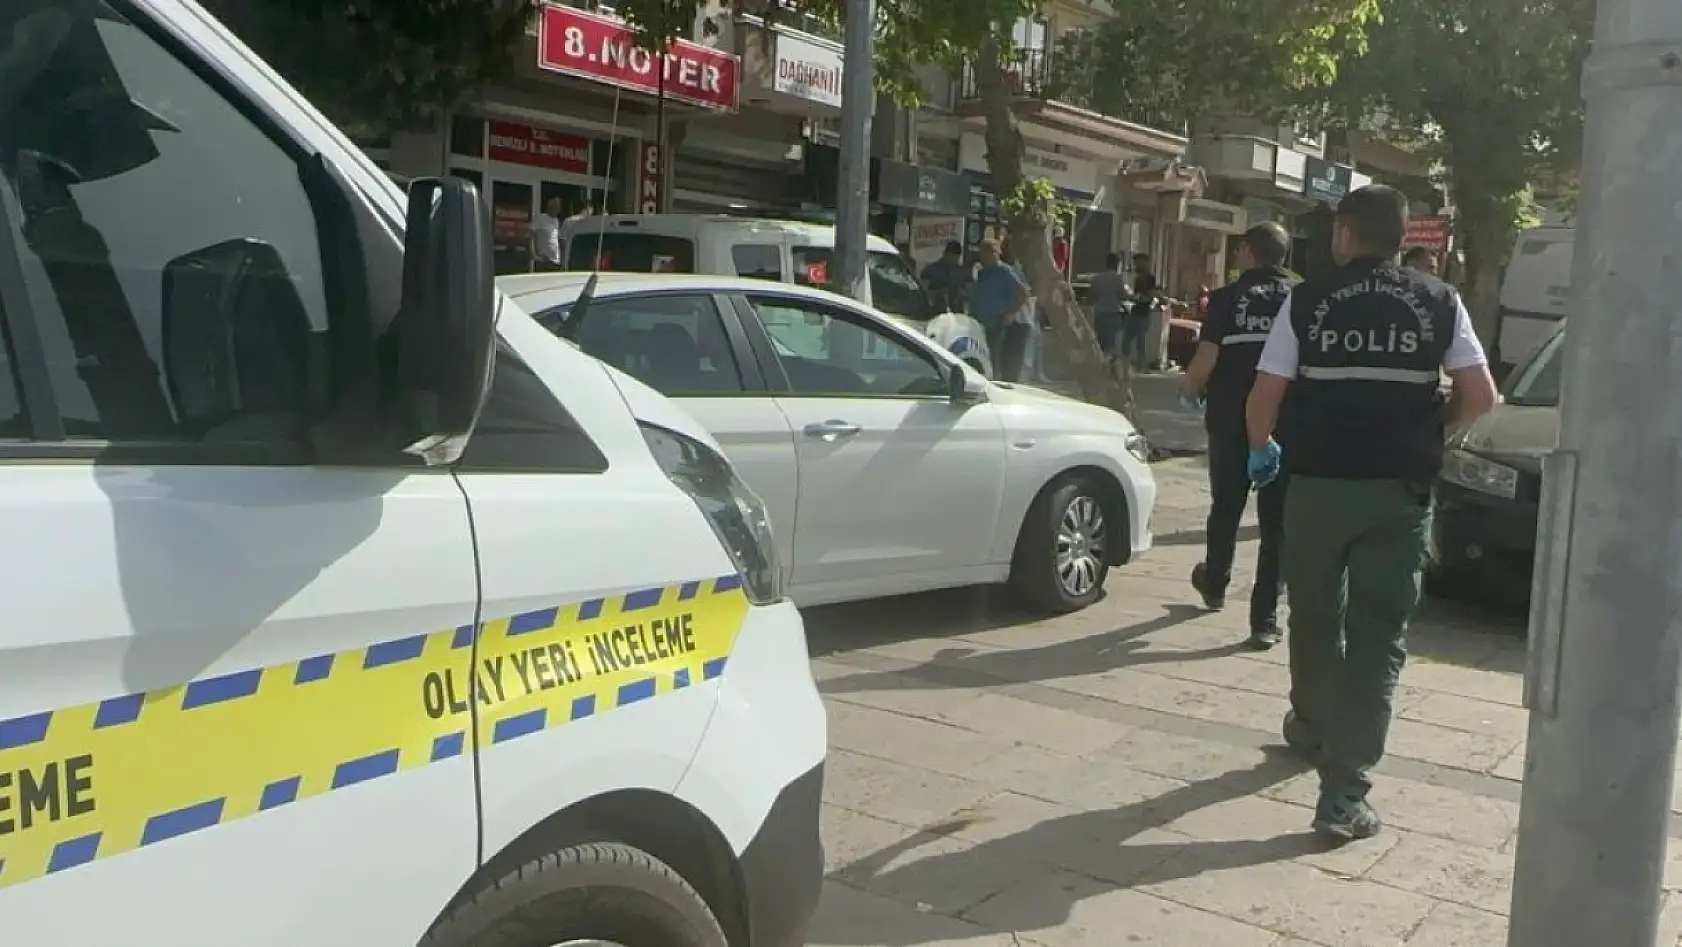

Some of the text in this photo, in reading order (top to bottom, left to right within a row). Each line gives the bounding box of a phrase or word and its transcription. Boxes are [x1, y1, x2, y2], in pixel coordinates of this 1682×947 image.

[1321, 322, 1418, 353] POLİS
[423, 613, 696, 719] OLAY YERİ İNCELEME
